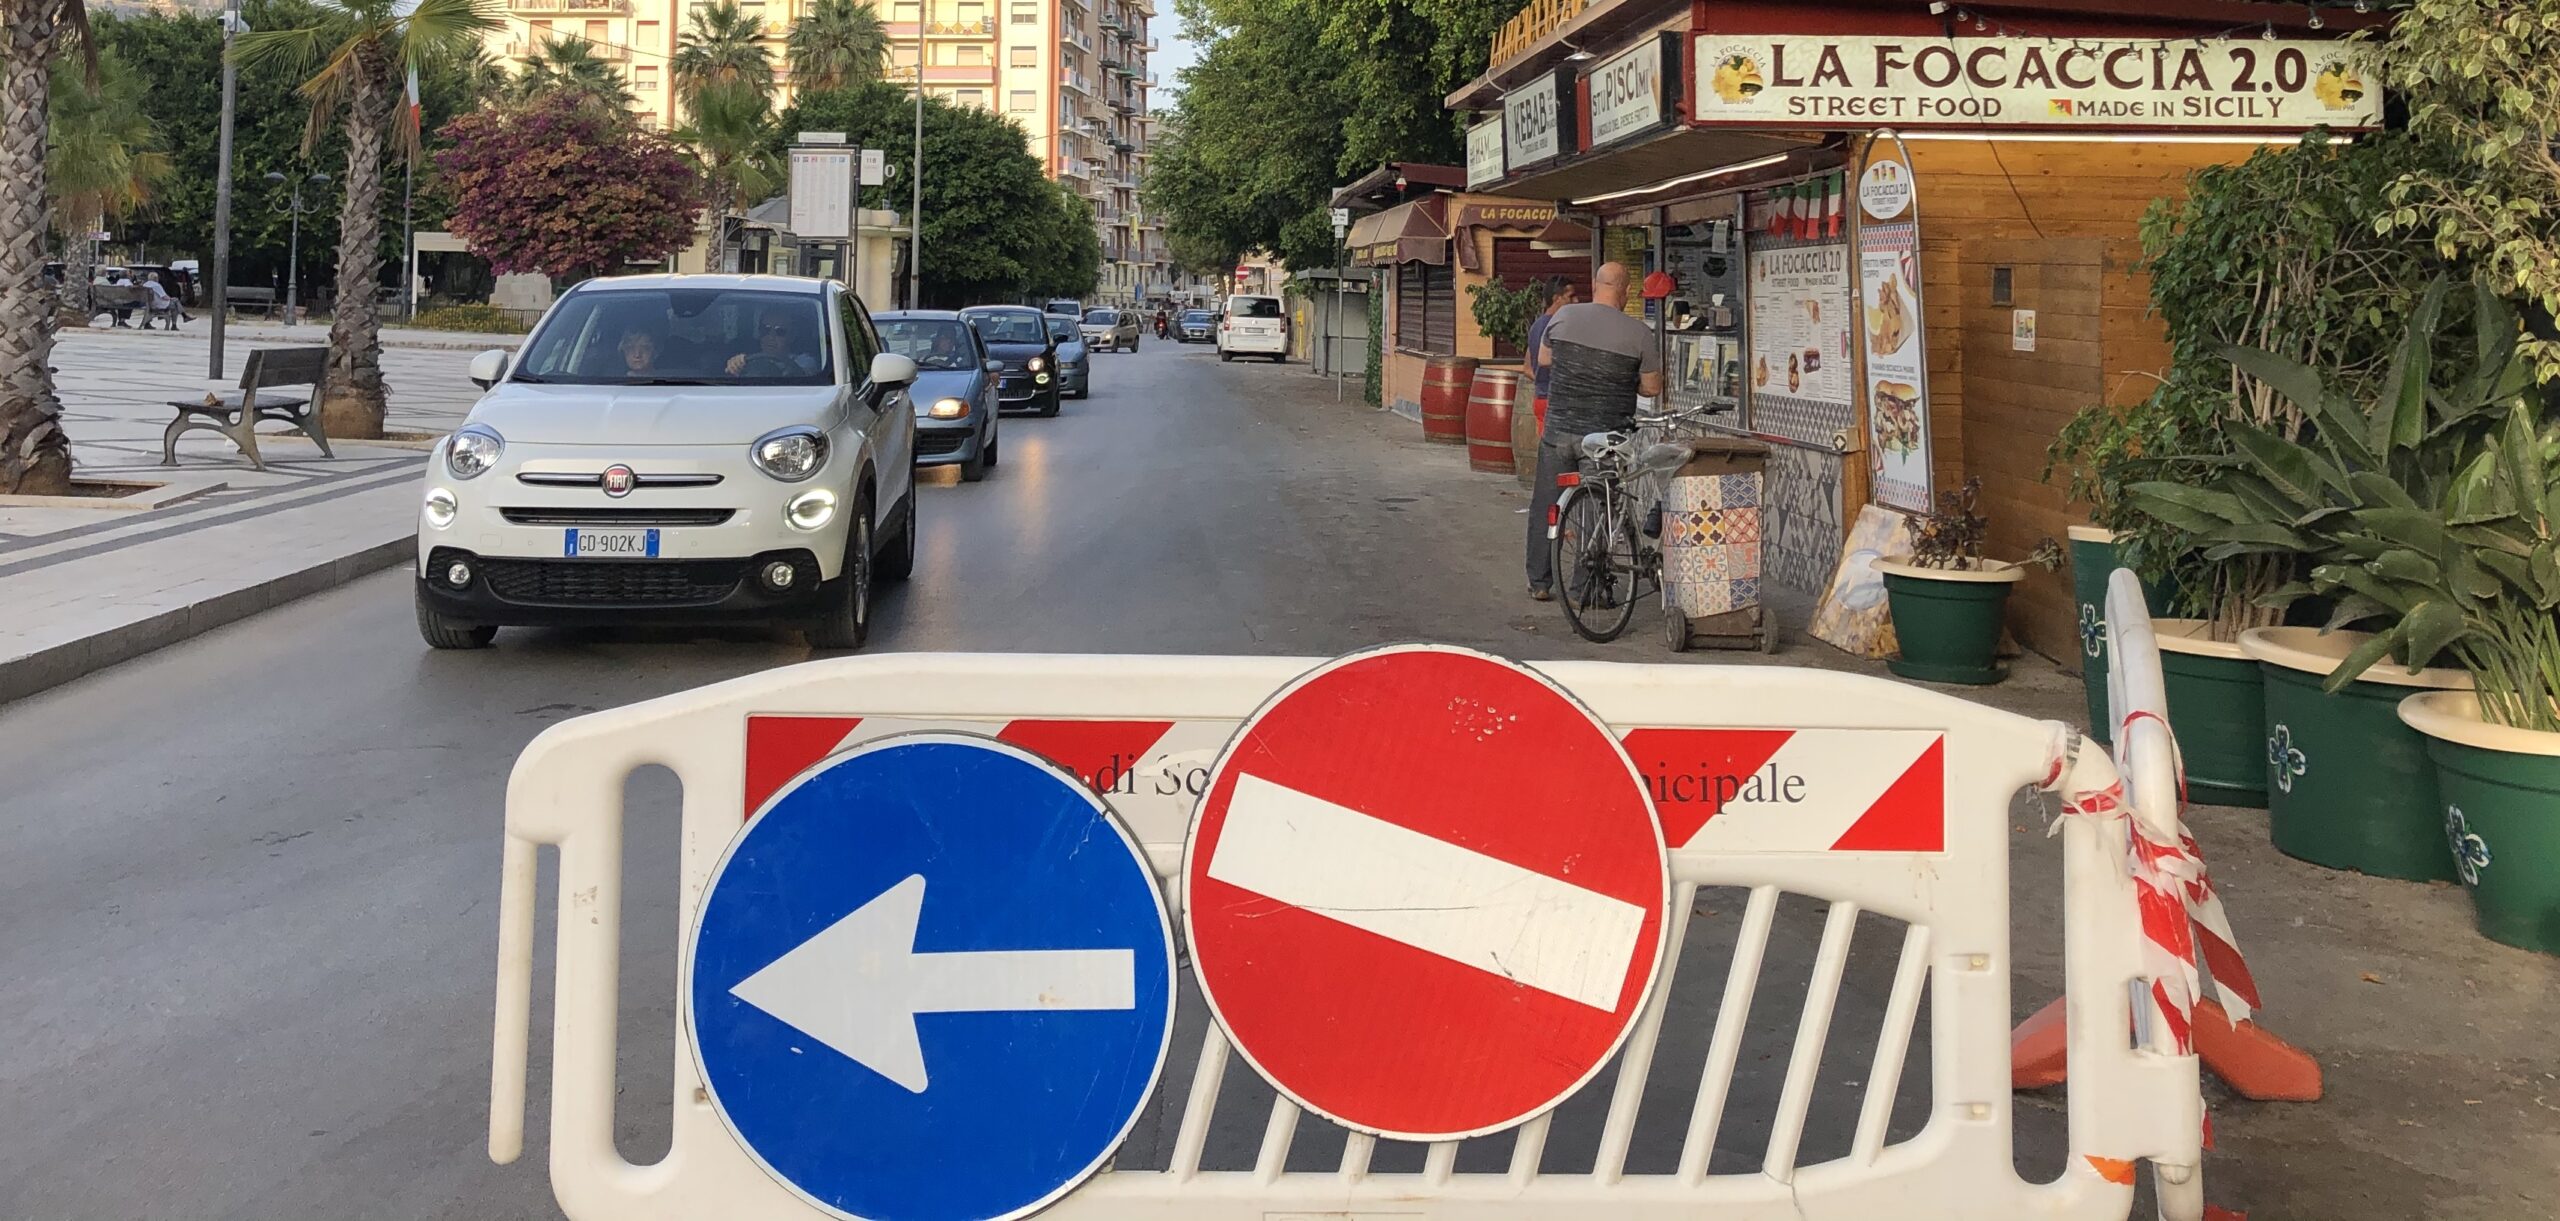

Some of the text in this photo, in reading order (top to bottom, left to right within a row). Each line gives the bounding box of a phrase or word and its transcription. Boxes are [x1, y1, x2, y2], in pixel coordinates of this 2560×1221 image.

[1770, 44, 1853, 88] LA
[1874, 44, 2214, 91] FOCACCIA
[2228, 46, 2308, 93] 2.0
[1788, 96, 2002, 117] STREET FOOD
[2077, 96, 2285, 118] MADE IN SICILY
[1513, 92, 1547, 149] KEBAB
[1481, 207, 1496, 219] LA
[1770, 250, 1841, 275] LA FOCACCIA 2.0
[609, 474, 627, 489] FIAT
[1095, 753, 1138, 795] di
